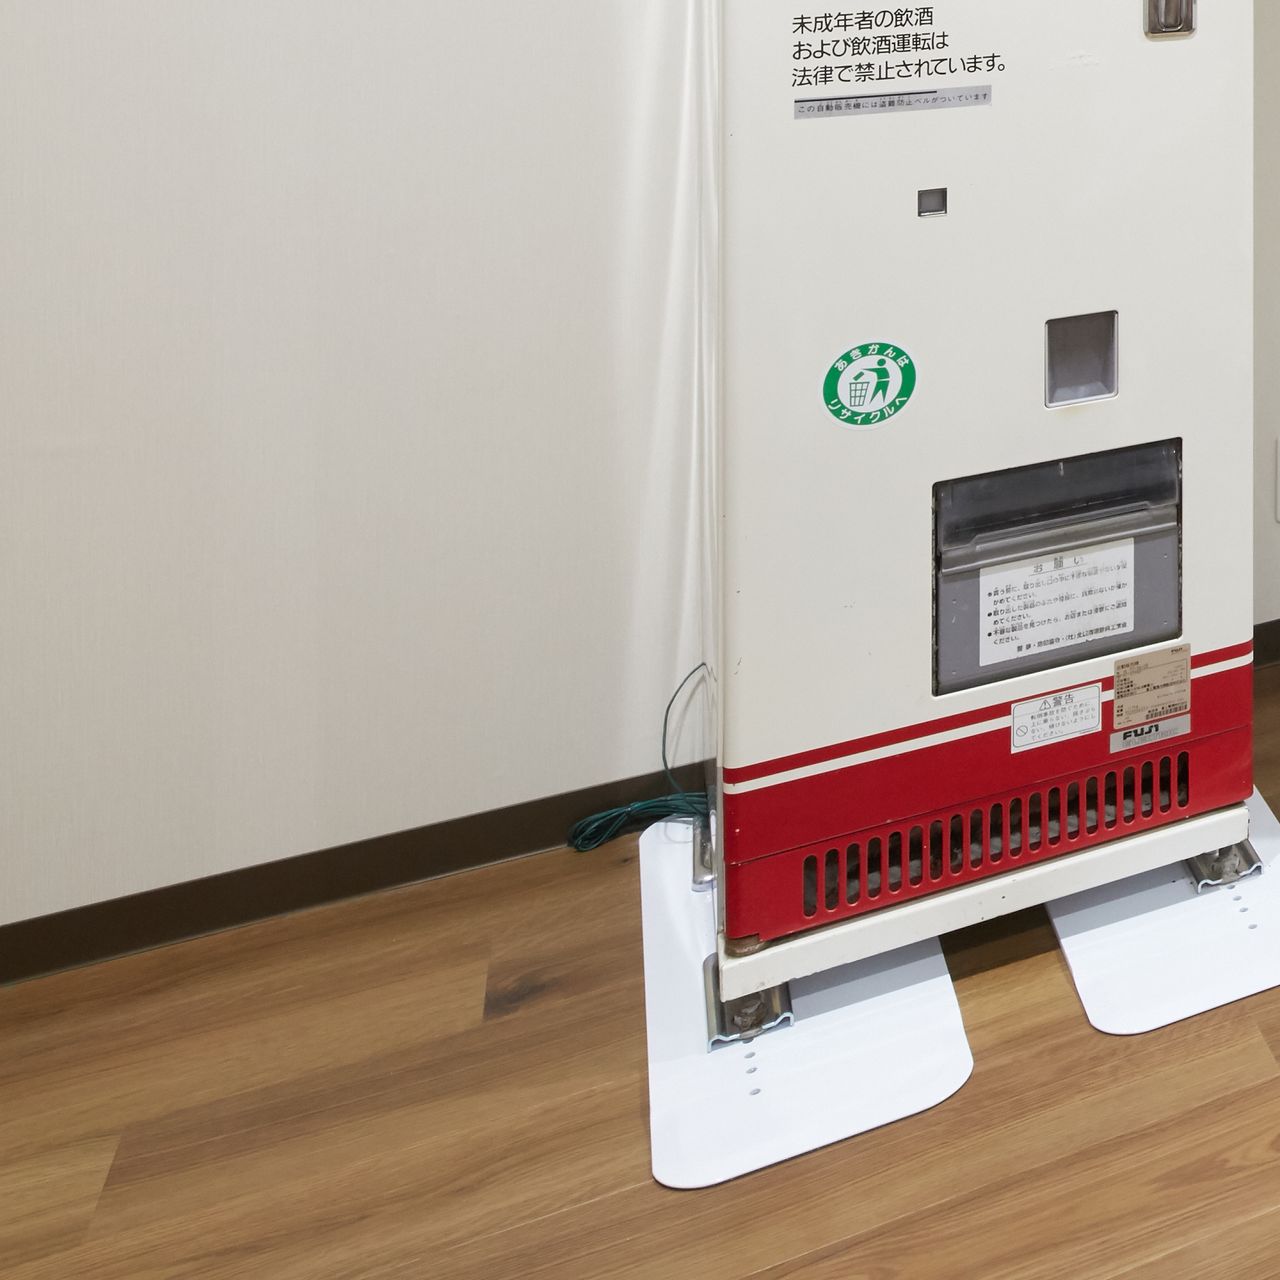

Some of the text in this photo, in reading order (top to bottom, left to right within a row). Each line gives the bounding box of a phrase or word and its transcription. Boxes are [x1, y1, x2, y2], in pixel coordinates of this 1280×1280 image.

[792, 7, 934, 34] 未成年者の飲酒
[792, 31, 949, 60] および飲酒運転は
[792, 53, 1006, 87] 法律で禁止されています。
[834, 343, 910, 372] あきかんは
[827, 397, 908, 425] リサイクルへ
[1052, 694, 1075, 707] 警告
